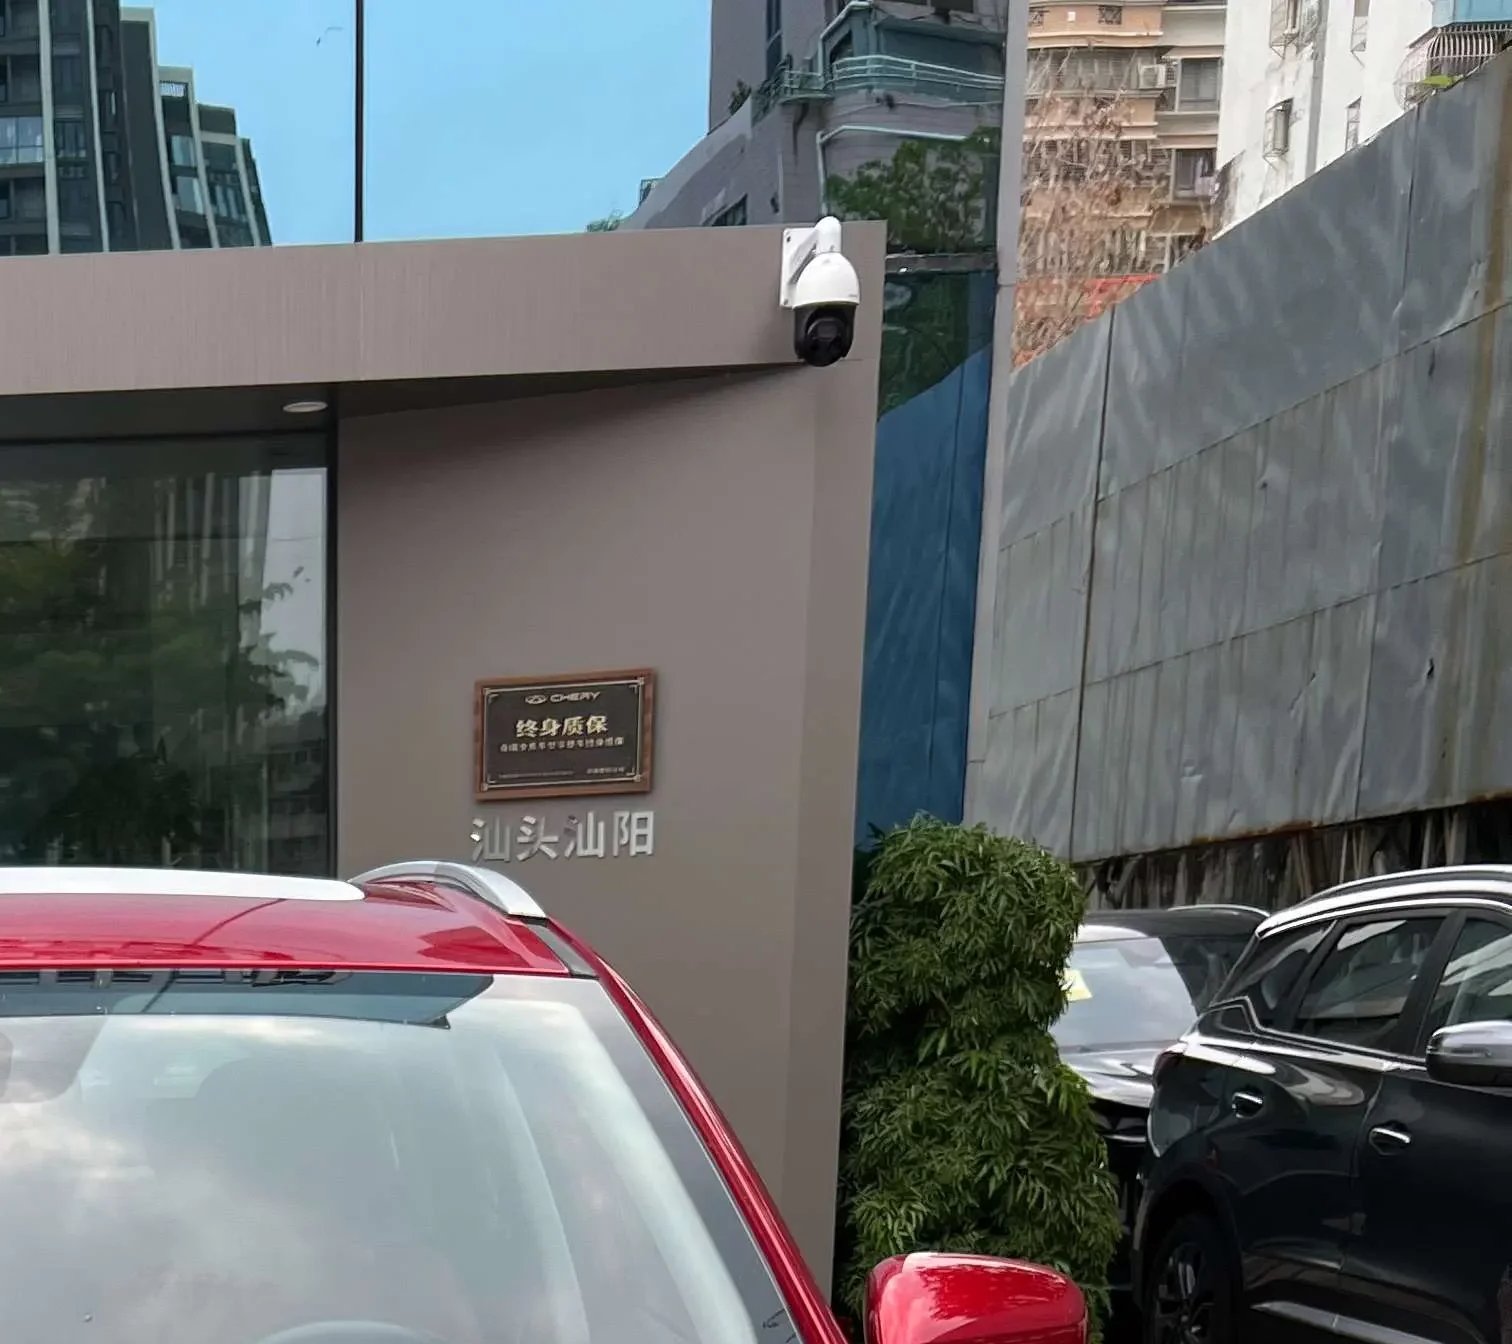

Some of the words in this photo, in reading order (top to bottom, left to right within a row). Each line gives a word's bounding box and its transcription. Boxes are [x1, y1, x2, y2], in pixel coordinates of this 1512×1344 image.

[550, 691, 601, 703] CHERY
[515, 714, 609, 738] 终身质保
[470, 810, 655, 862] 汕头汕阳
